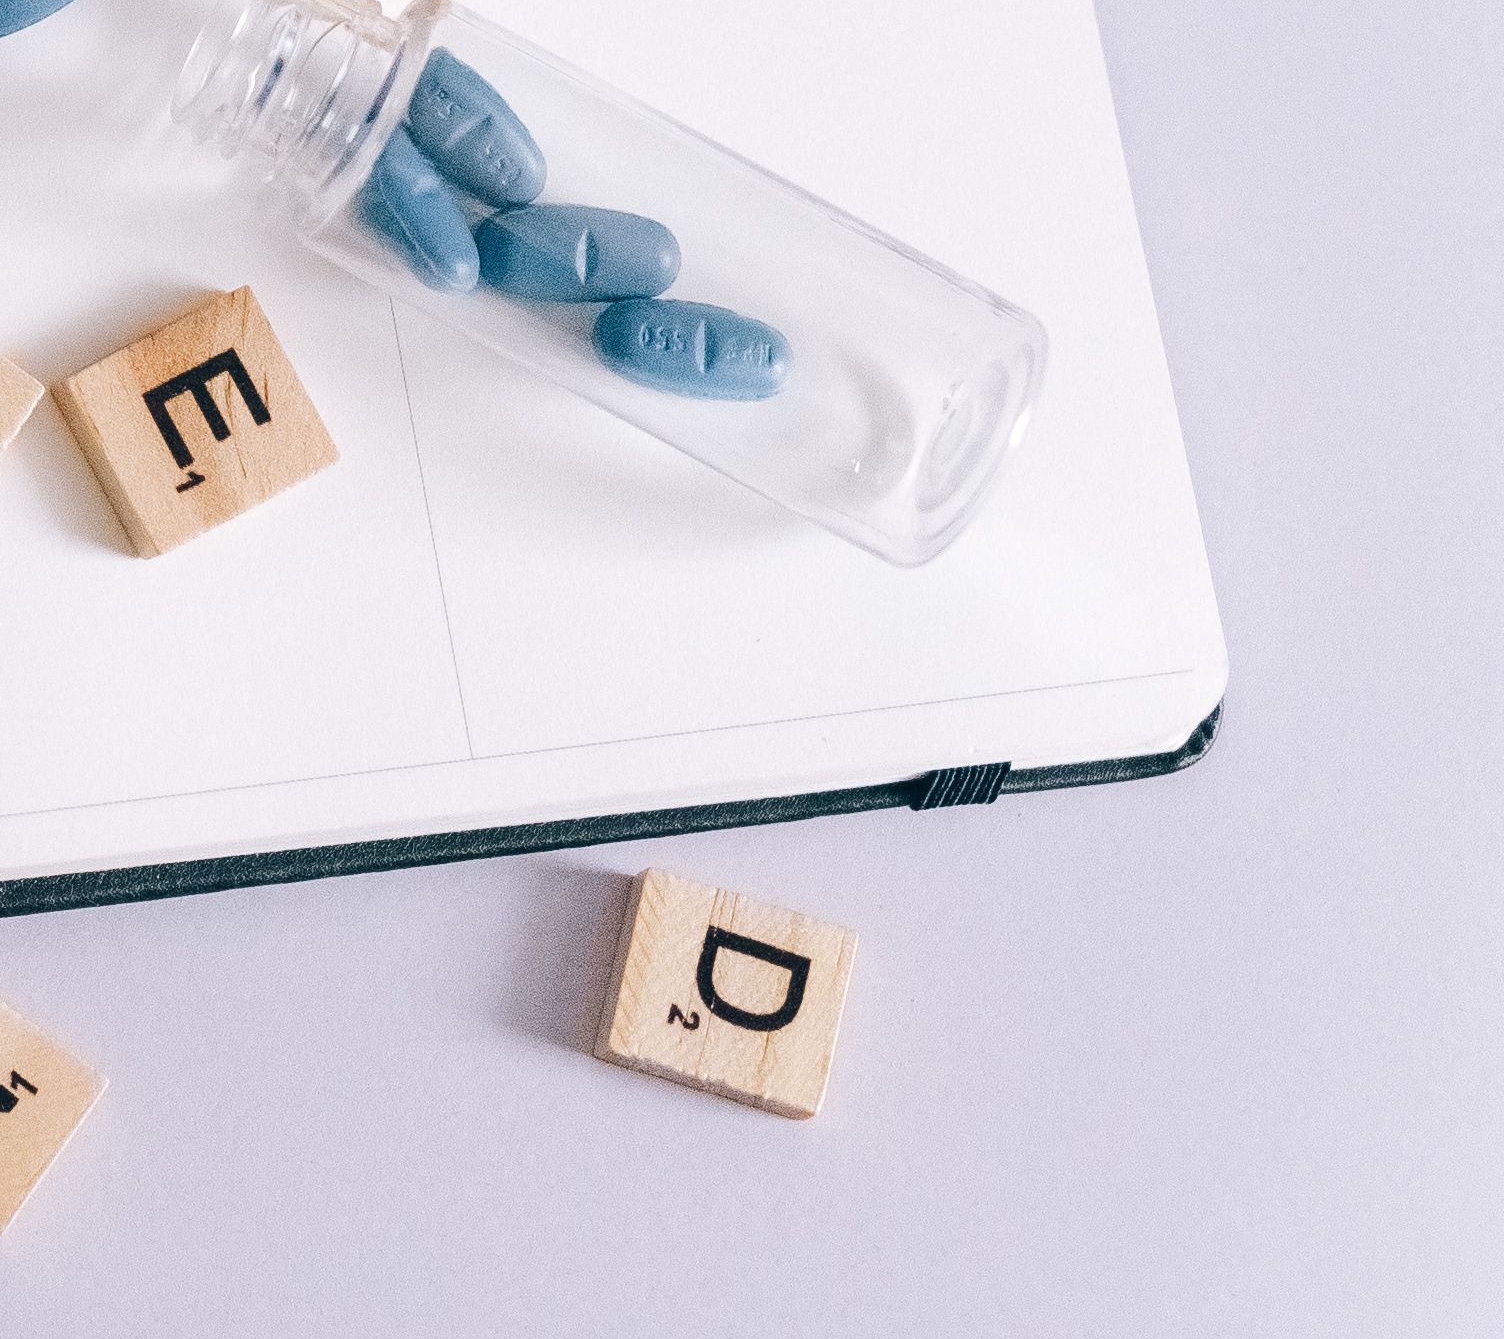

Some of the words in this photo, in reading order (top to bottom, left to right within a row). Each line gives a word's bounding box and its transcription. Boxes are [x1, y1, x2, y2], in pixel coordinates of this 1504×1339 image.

[142, 348, 273, 468] E
[175, 467, 204, 495] 1
[696, 925, 811, 1032] D
[668, 1004, 700, 1030] 2
[11, 1070, 38, 1096] 1
